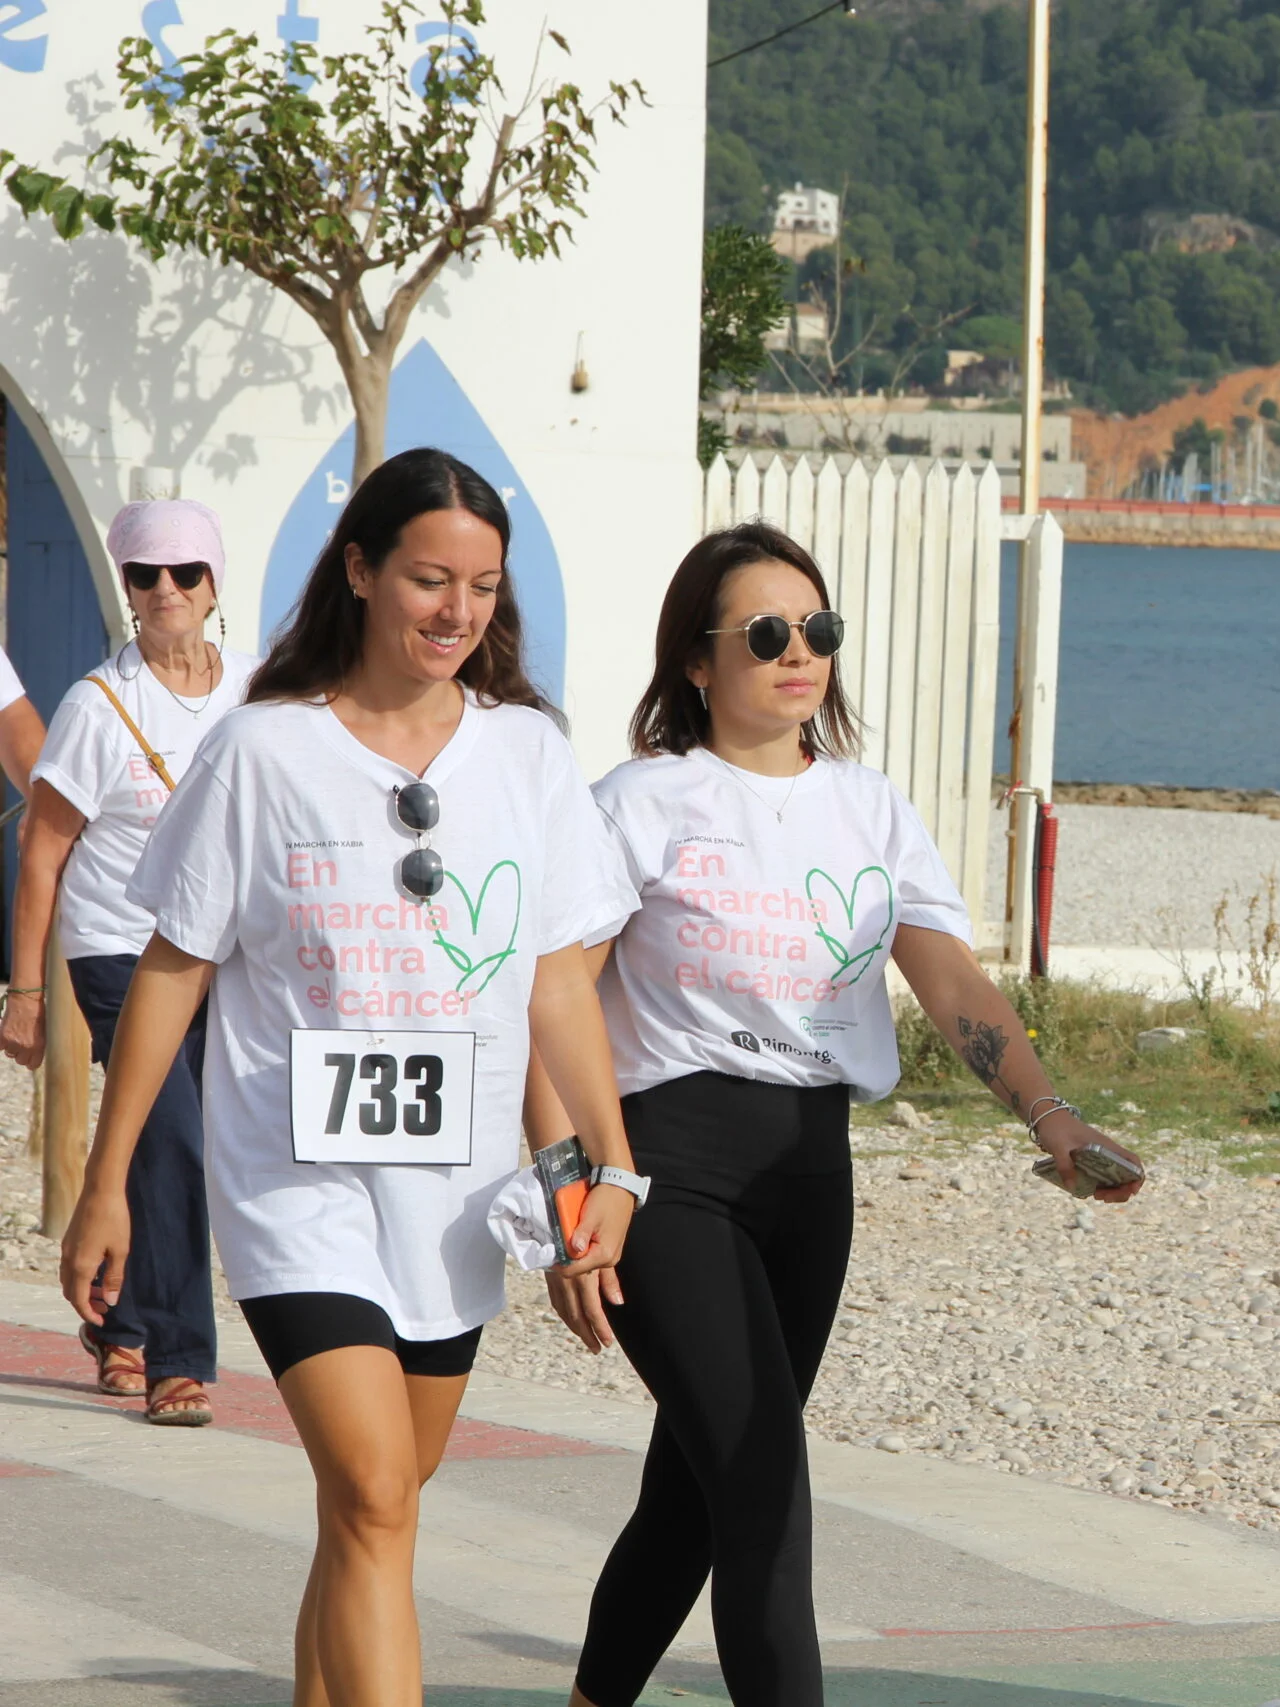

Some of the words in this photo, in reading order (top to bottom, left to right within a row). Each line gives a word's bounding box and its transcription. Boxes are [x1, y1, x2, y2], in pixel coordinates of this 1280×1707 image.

[294, 840, 327, 849] MARCHA
[676, 845, 726, 879] En
[287, 853, 337, 888] En
[287, 895, 449, 931] marcha
[675, 886, 828, 924] marcha
[297, 938, 425, 974] contra
[676, 921, 807, 962] contra
[306, 977, 331, 1009] el
[336, 980, 479, 1017] cáncer
[675, 956, 714, 990] el
[724, 964, 849, 1003] cáncer
[324, 1053, 444, 1136] 733
